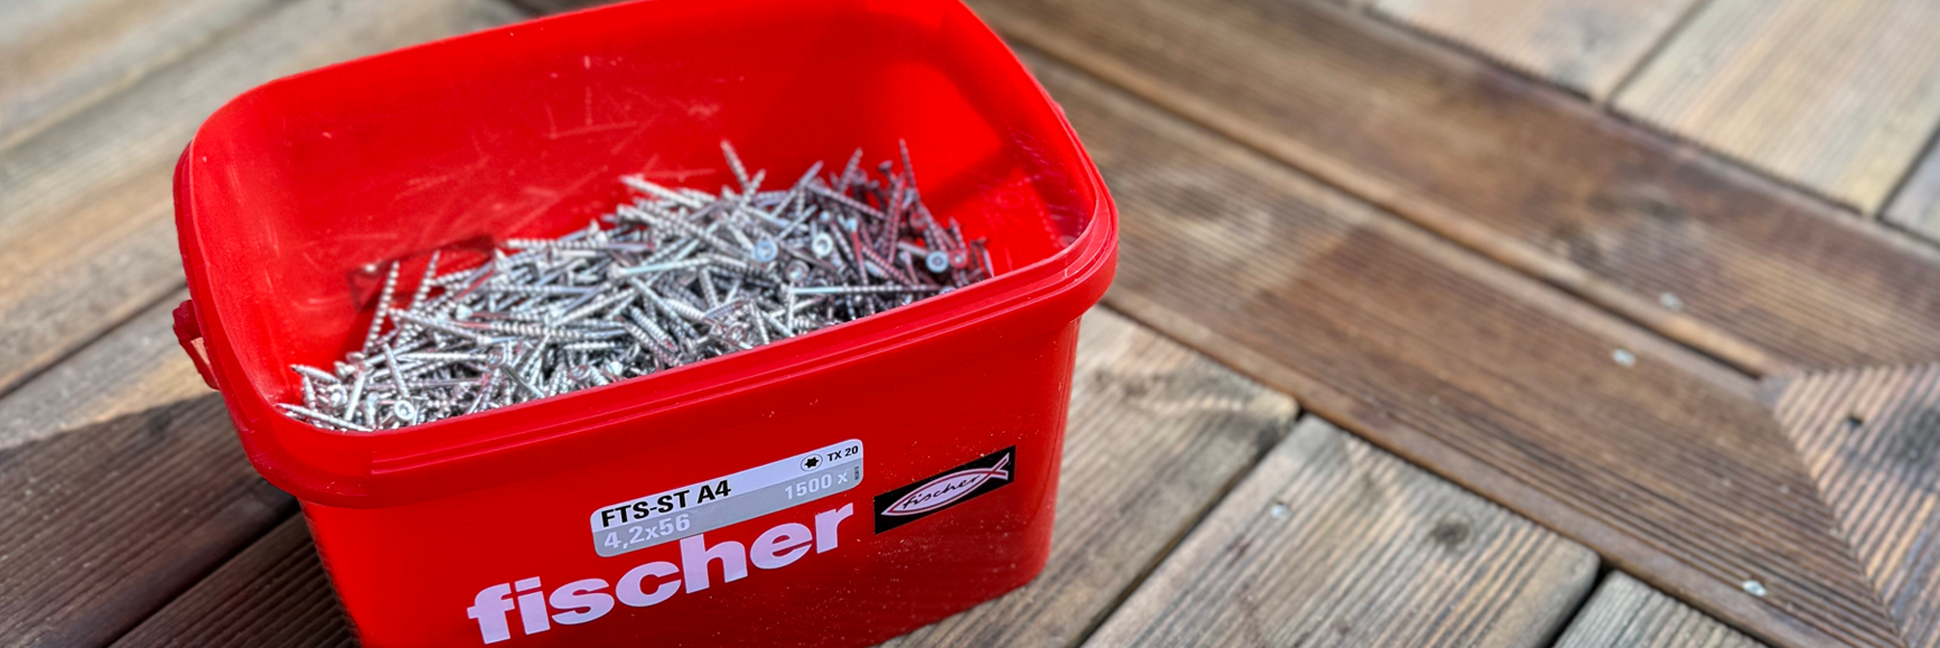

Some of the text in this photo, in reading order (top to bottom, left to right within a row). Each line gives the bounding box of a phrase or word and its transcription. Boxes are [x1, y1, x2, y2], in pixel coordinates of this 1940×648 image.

[826, 445, 859, 462] TX 20
[601, 479, 732, 528] FTS-ST A4
[784, 474, 832, 501] 1500
[837, 472, 849, 484] x
[902, 473, 981, 510] fischer
[603, 513, 691, 549] 4,2x56
[467, 502, 854, 645] fischer
